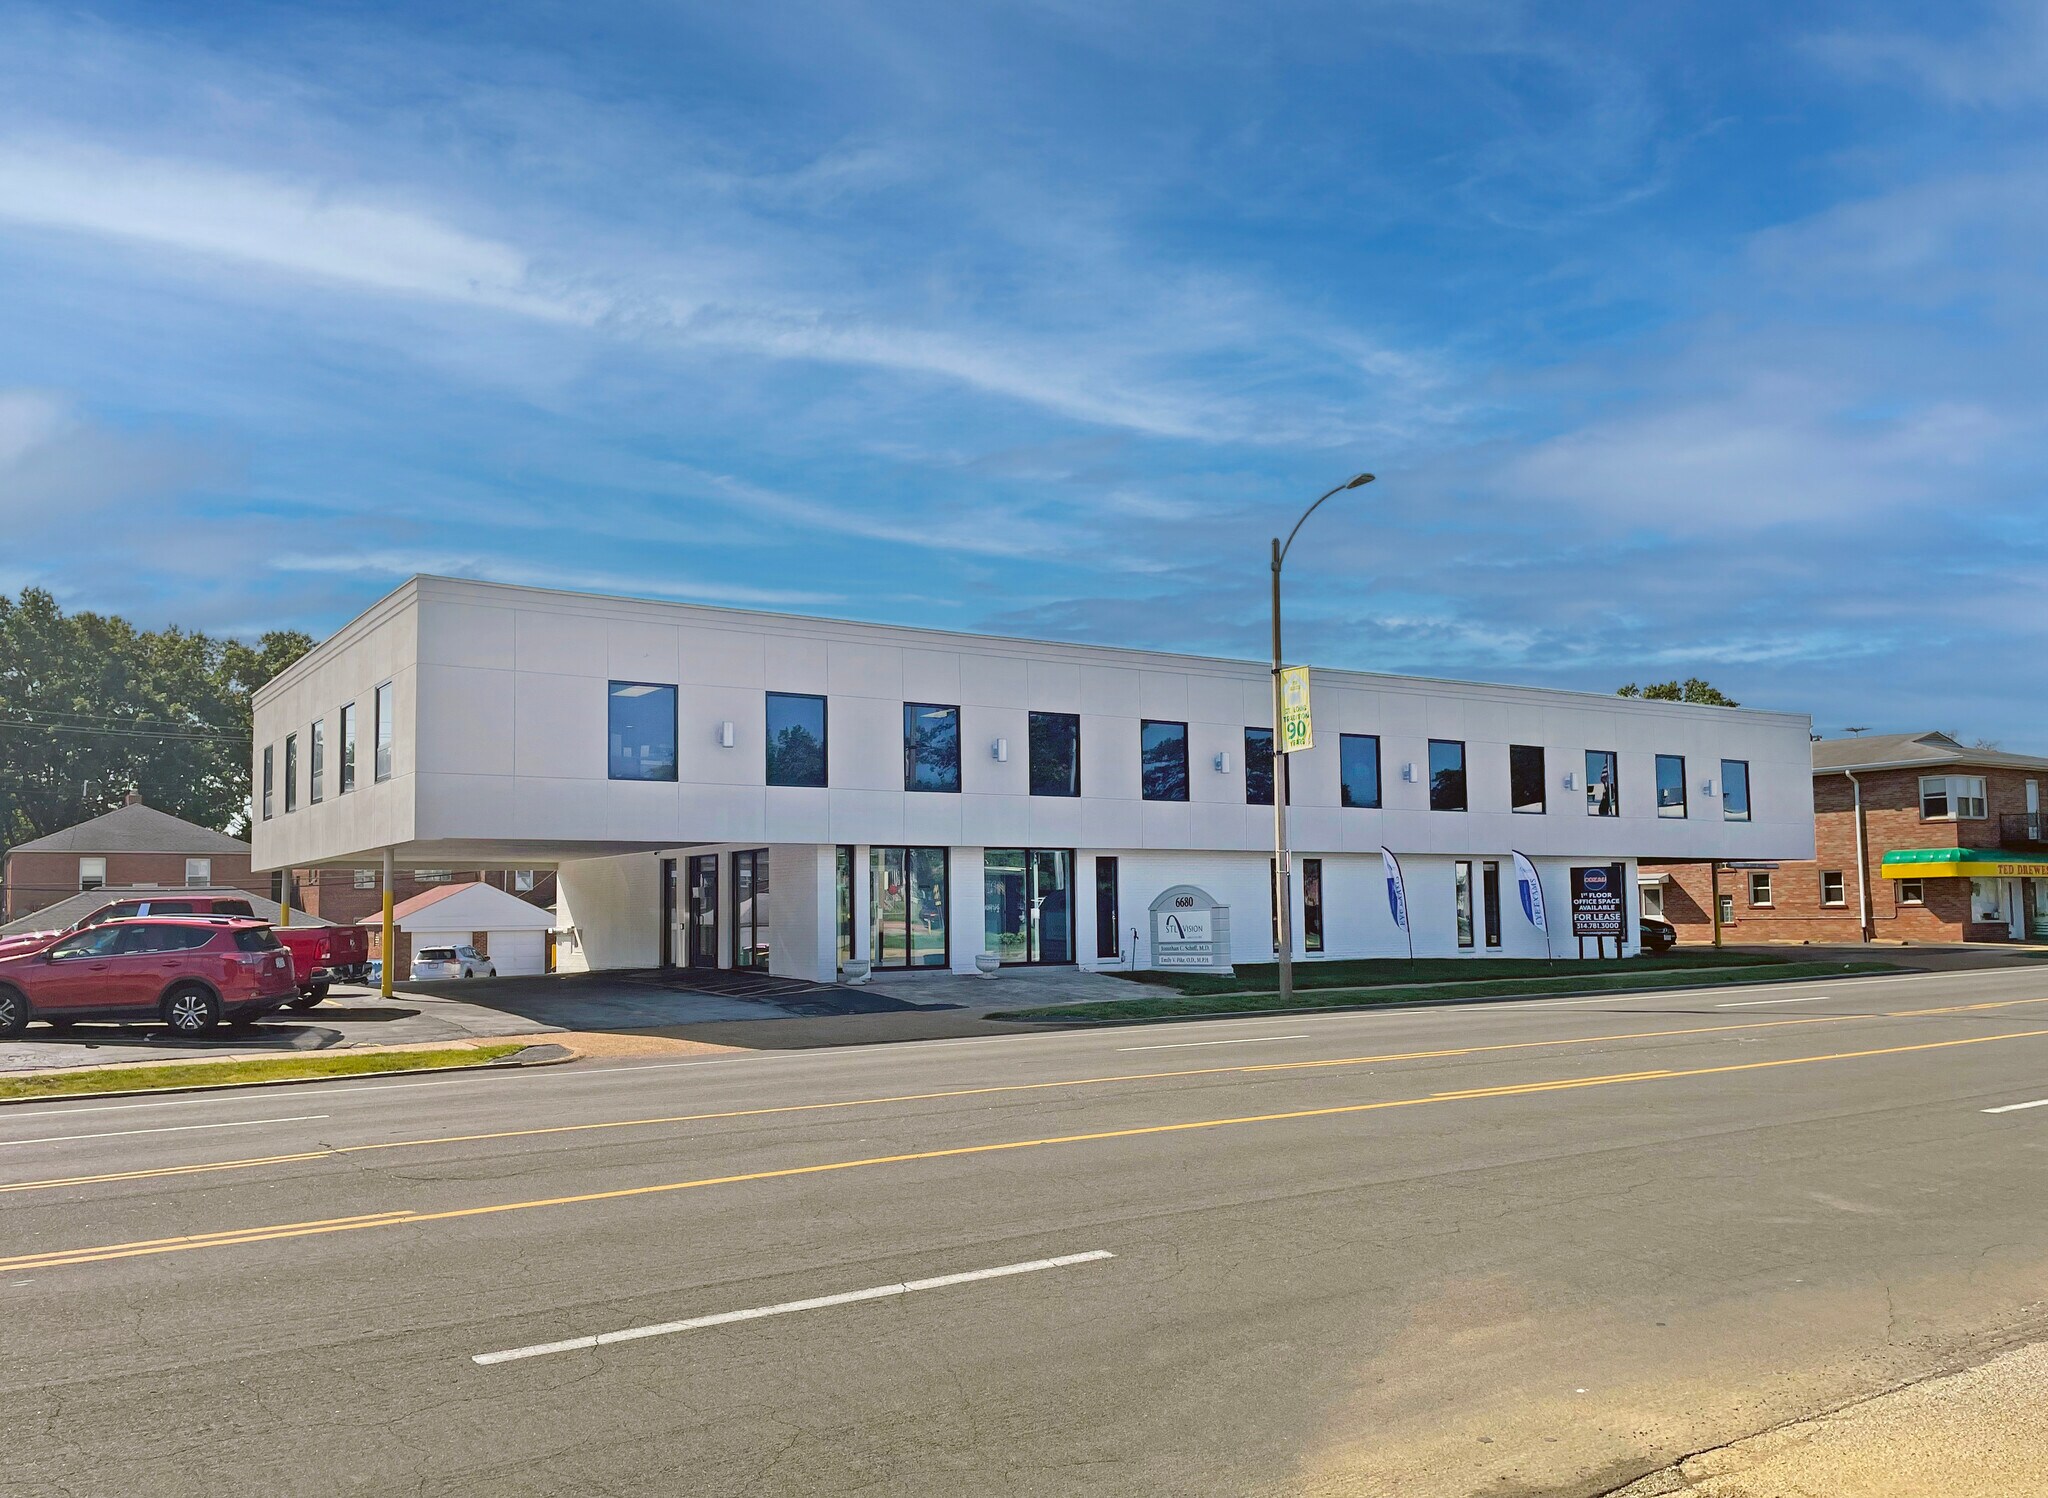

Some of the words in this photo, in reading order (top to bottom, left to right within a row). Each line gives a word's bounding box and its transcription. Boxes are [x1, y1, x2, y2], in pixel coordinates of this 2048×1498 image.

[1287, 720, 1306, 740] 90
[1997, 864, 2014, 875] TED
[1175, 896, 1194, 908] 6680
[1574, 913, 1592, 921] FOR
[1593, 913, 1621, 921] LEASE
[1183, 925, 1203, 933] VISION
